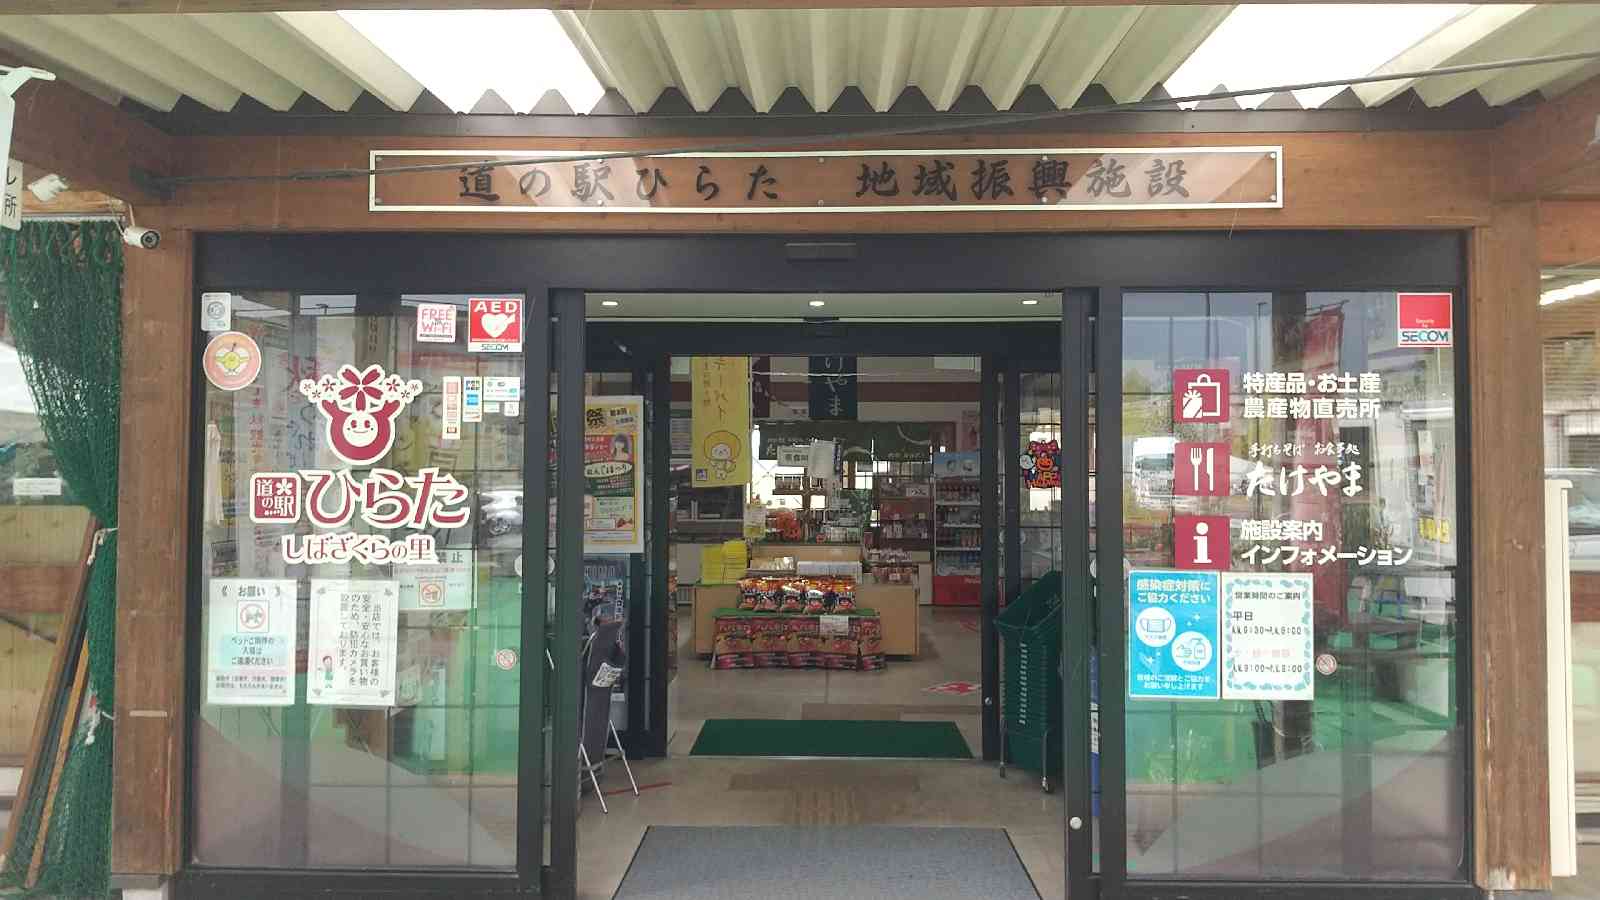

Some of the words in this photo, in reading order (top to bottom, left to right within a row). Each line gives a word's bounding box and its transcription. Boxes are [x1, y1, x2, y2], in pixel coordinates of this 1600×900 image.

[459, 160, 778, 201] 道の駅ひらた
[856, 158, 1190, 199] 地域振興施設
[474, 301, 518, 313] AED
[1401, 330, 1449, 342] SECOM
[481, 343, 510, 351] SECOM
[1243, 372, 1382, 394] 特産品・お土産
[1243, 398, 1382, 419] 農産物直売所
[1246, 461, 1363, 498] たけやま
[302, 469, 470, 529] ひらた
[1240, 520, 1323, 541] 施設案内
[284, 534, 435, 563] しばざくらの里
[1241, 545, 1413, 566] インフォメーション
